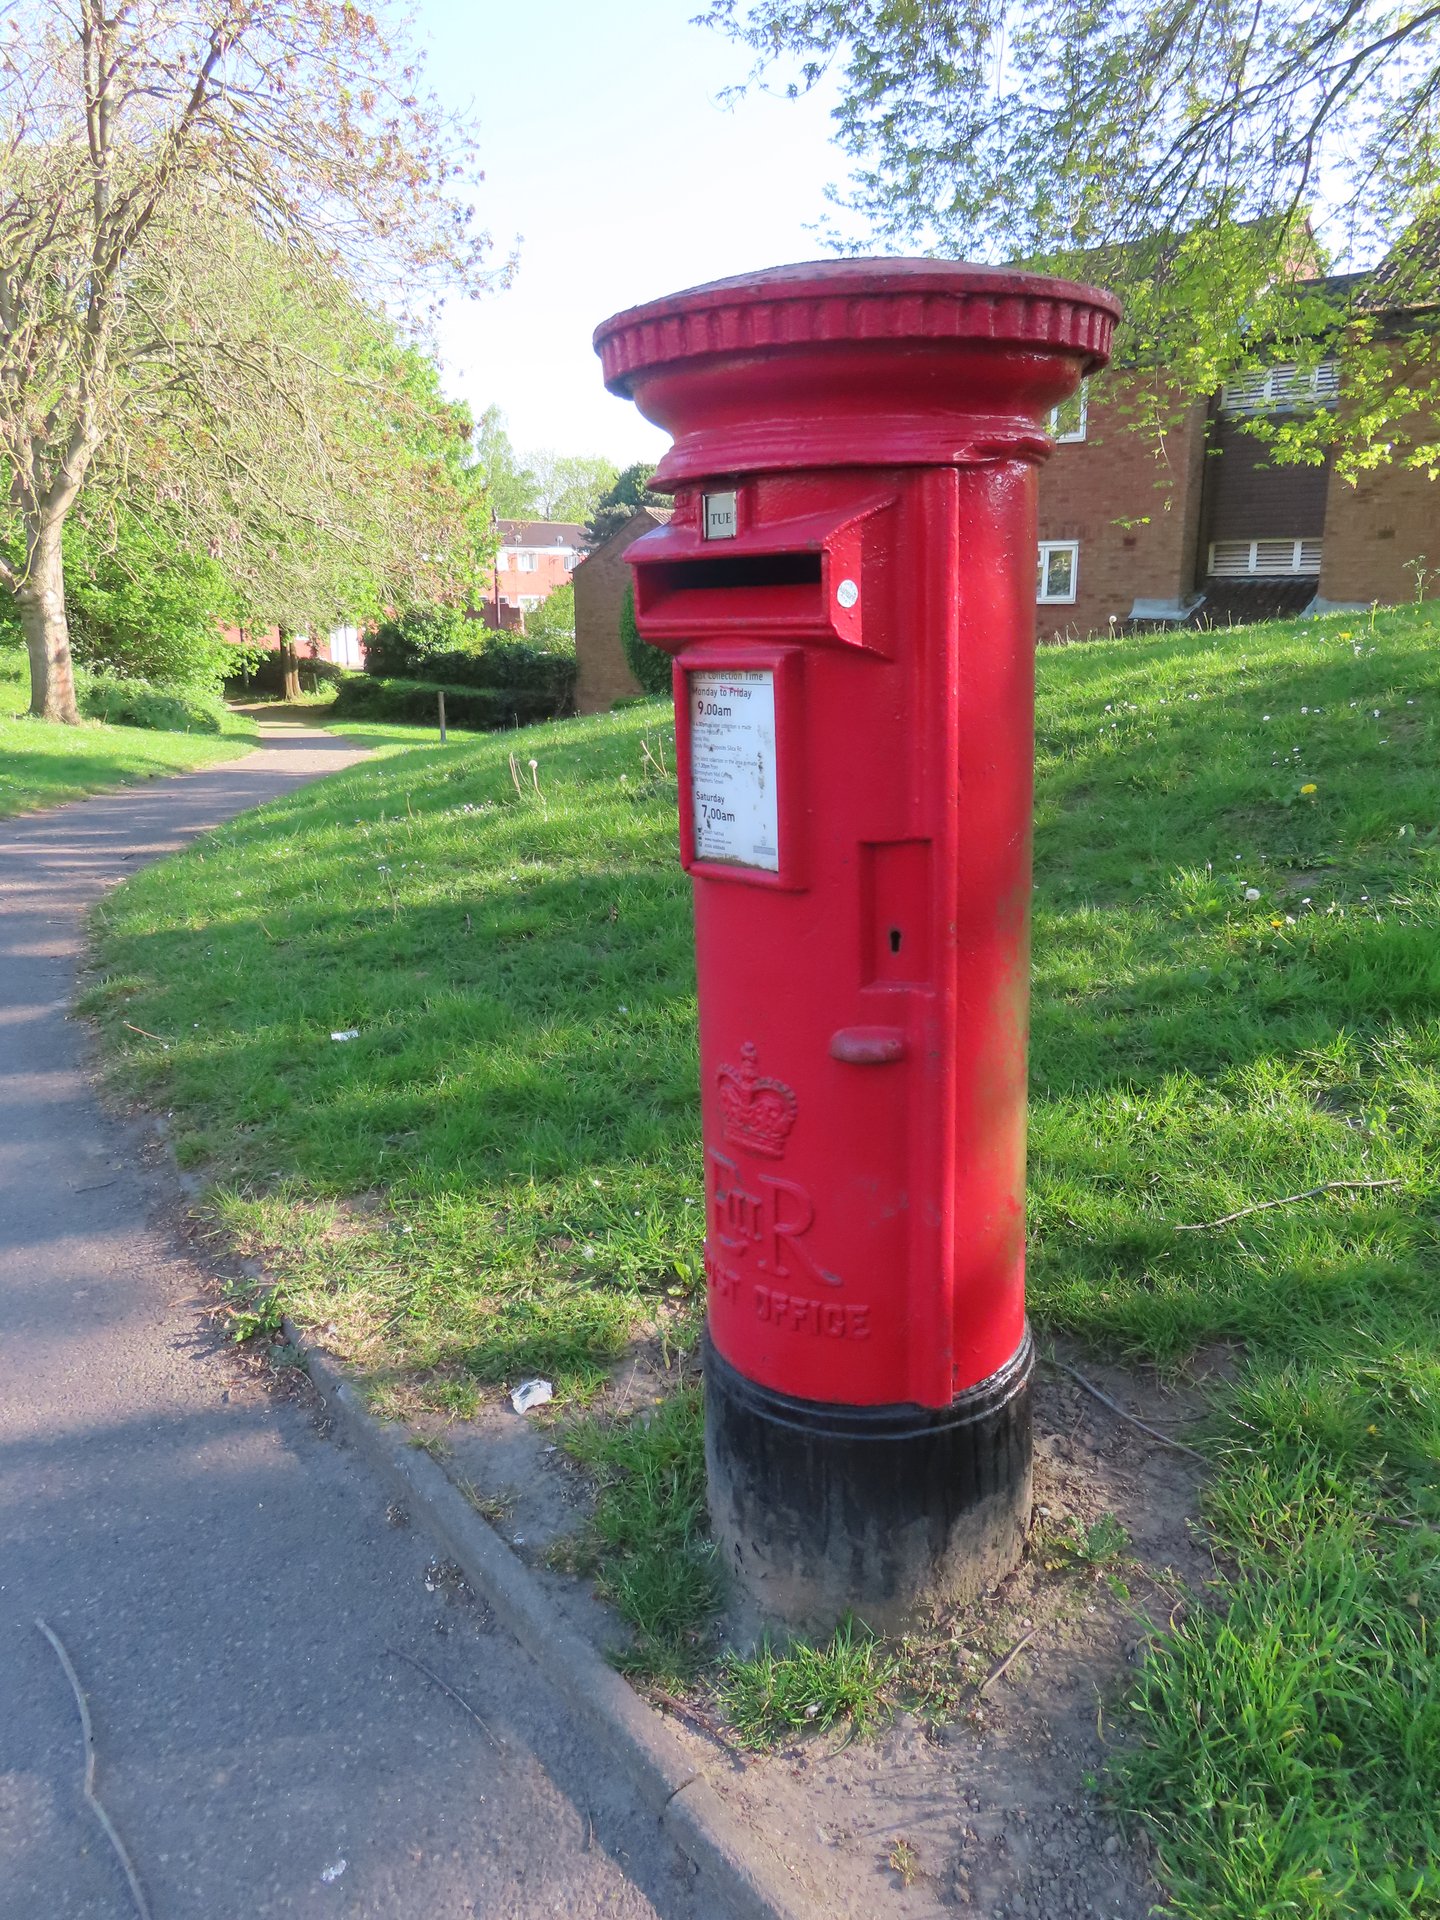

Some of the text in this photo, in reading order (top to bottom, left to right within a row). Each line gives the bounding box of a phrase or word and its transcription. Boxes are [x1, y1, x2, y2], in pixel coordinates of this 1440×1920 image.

[710, 512, 732, 525] TUE
[745, 672, 764, 681] Time
[720, 688, 727, 697] to
[729, 688, 752, 700] Friday
[698, 700, 732, 717] 9.00am
[696, 790, 725, 805] Saturday
[701, 804, 735, 822] 7.00am
[754, 1284, 870, 1339] OFFICE
